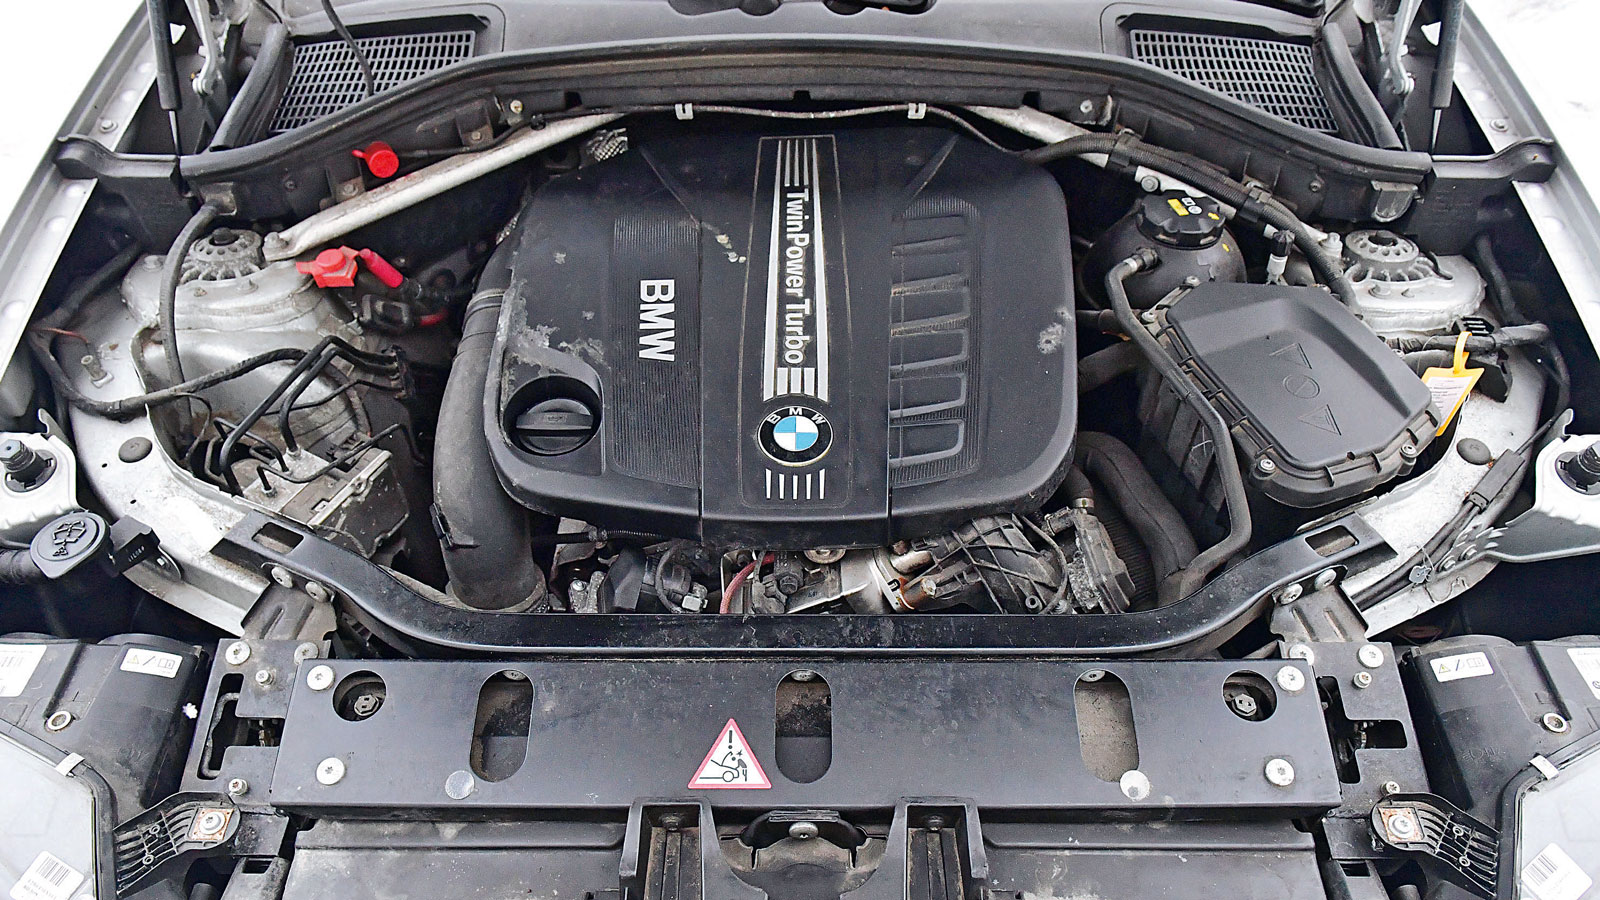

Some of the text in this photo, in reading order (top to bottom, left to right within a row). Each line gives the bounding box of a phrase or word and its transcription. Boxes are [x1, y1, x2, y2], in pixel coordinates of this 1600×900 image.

[784, 188, 811, 364] TwinPower Turbo
[638, 278, 676, 362] BMW
[767, 407, 826, 425] BMW
